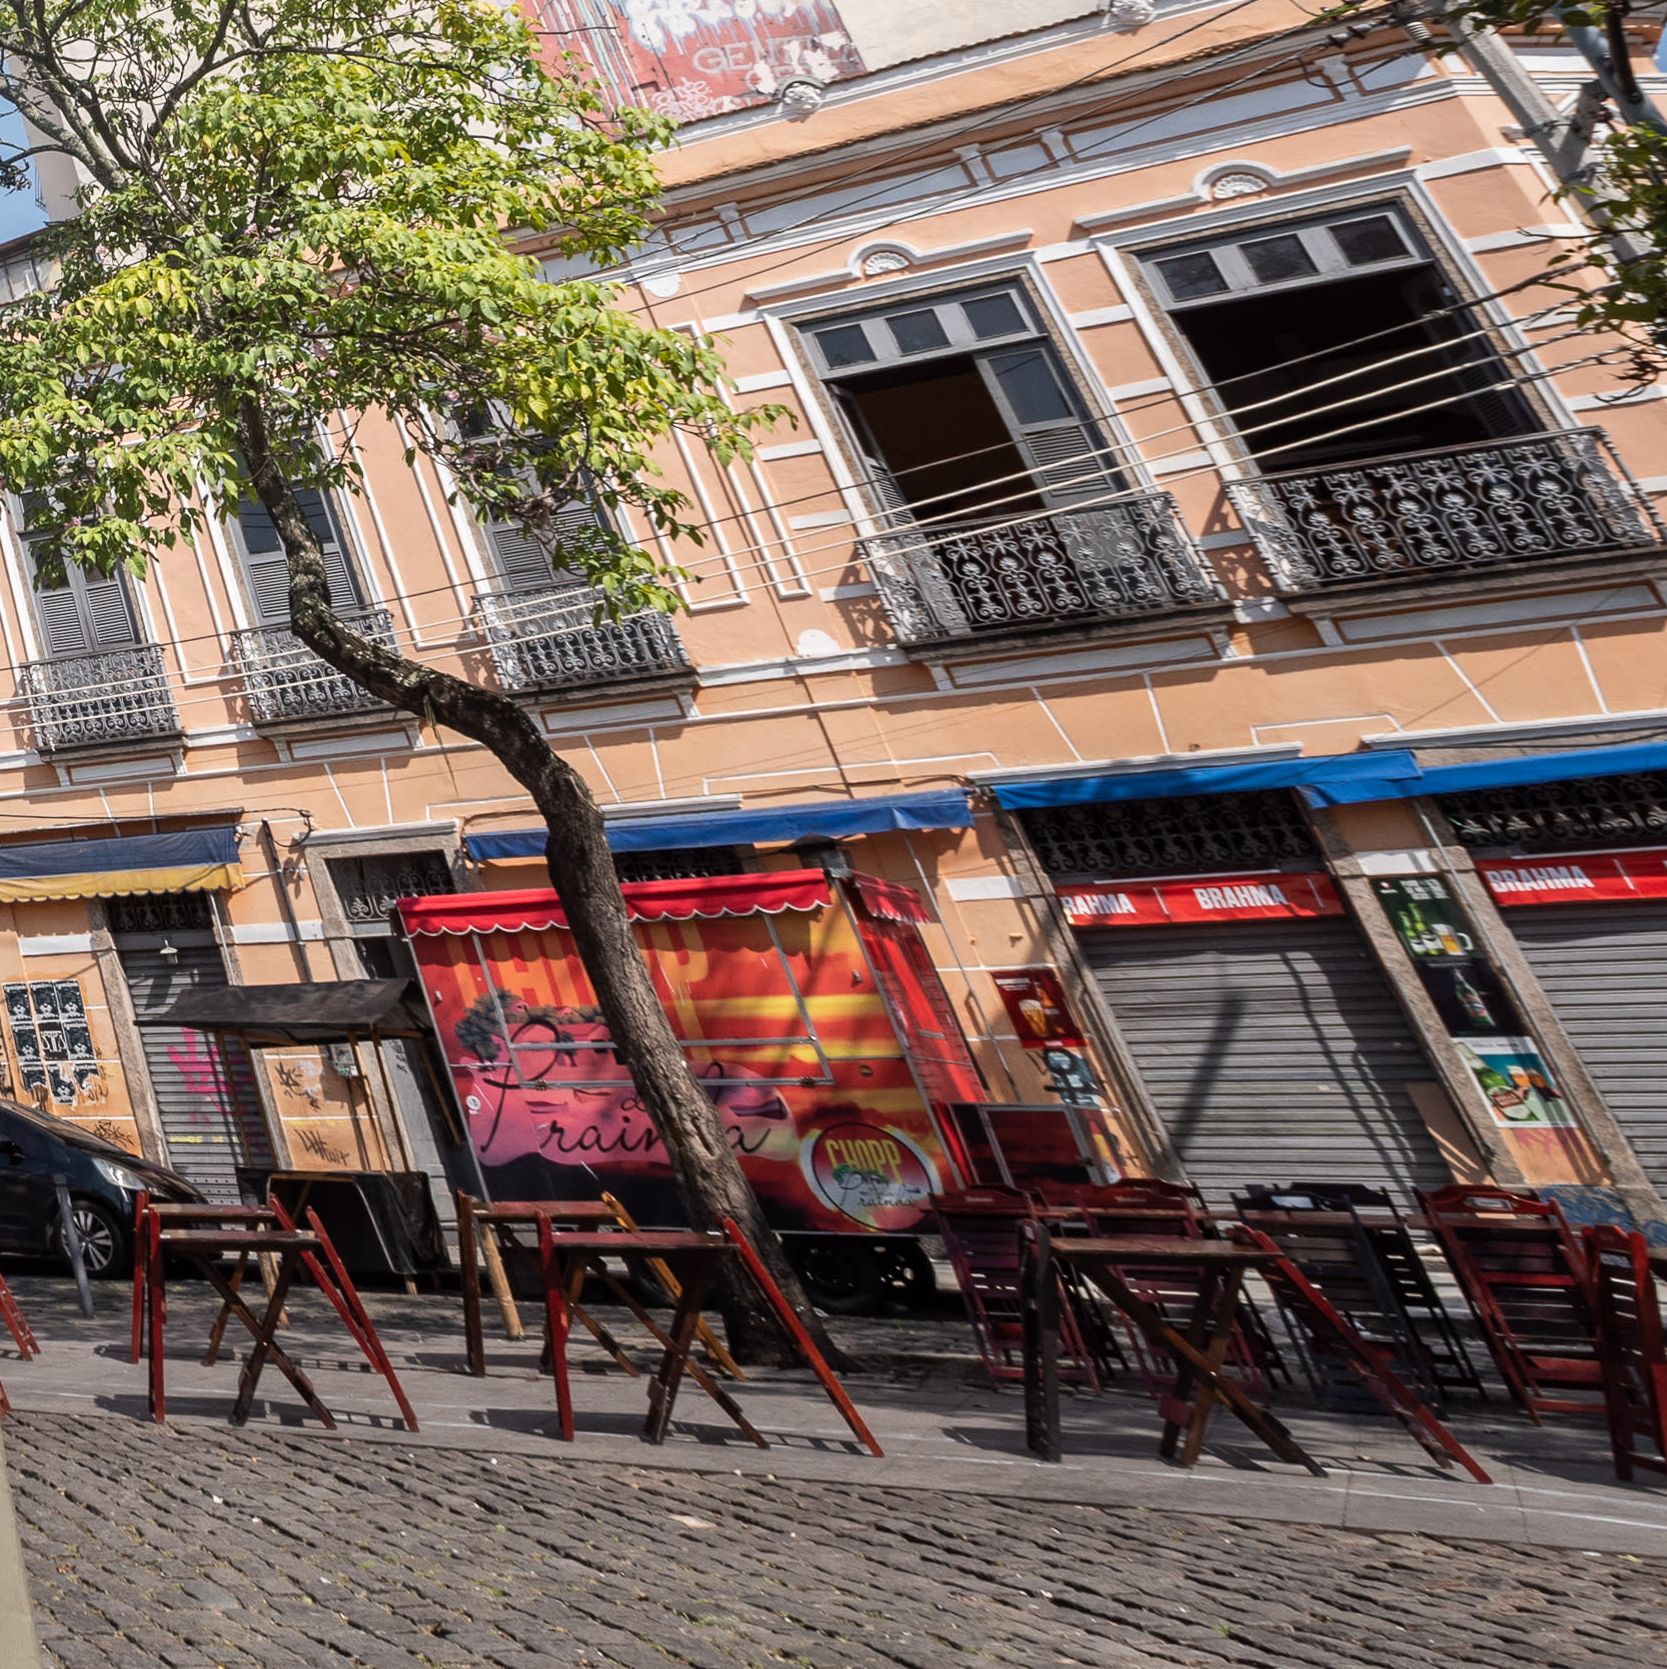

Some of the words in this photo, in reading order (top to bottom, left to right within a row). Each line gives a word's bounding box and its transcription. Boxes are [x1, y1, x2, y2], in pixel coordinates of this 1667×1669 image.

[1484, 866, 1595, 893] BRAHMA
[1060, 893, 1137, 916] RAHMA
[1192, 884, 1288, 910] BRAHMA
[824, 1139, 903, 1184] CHOPP
